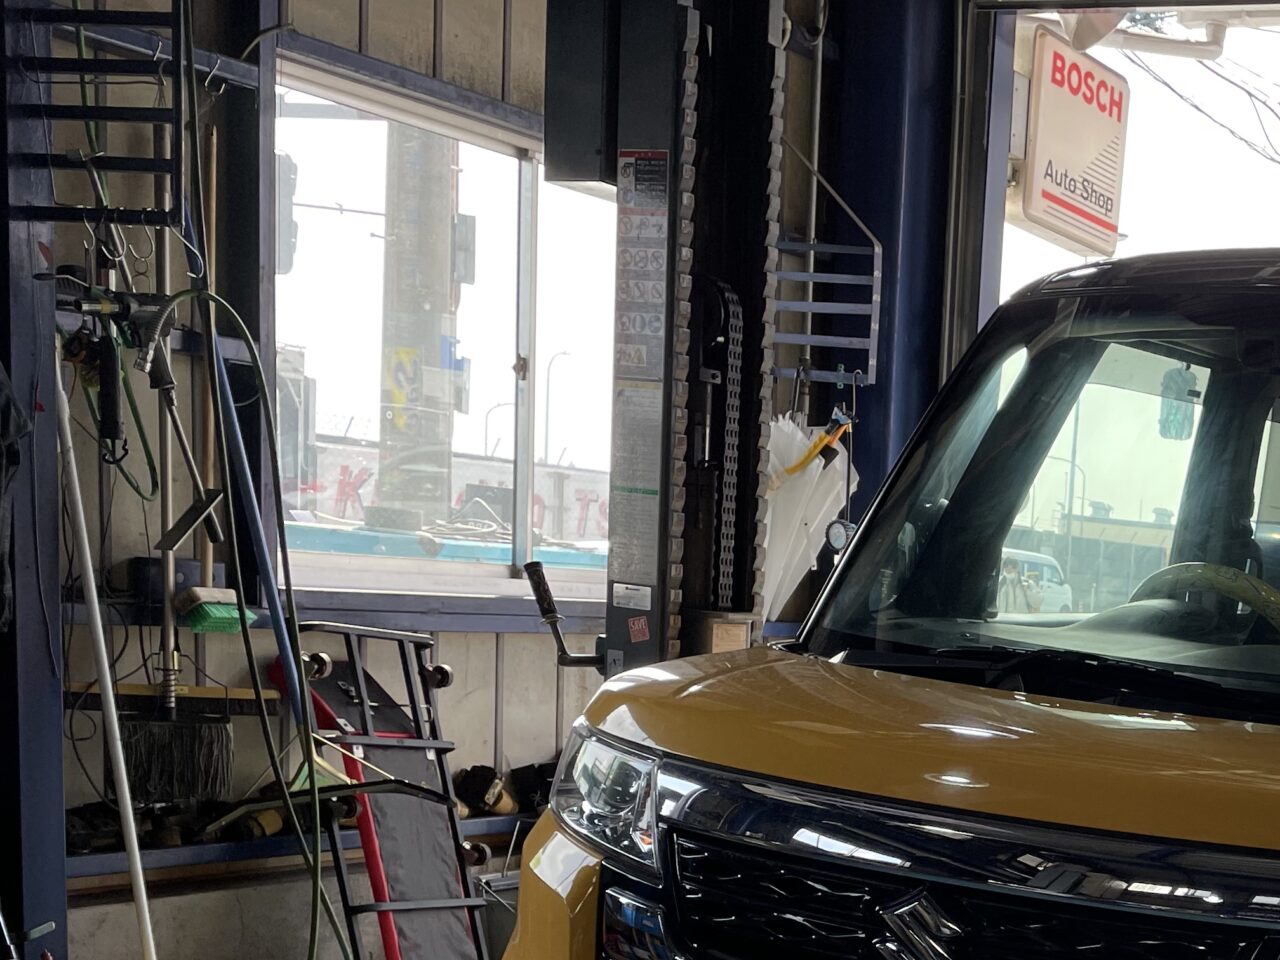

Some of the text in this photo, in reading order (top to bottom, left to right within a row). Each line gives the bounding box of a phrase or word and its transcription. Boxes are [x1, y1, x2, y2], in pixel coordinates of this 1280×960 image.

[1050, 50, 1124, 123] BOSCH
[1043, 159, 1114, 214] Auto Shop
